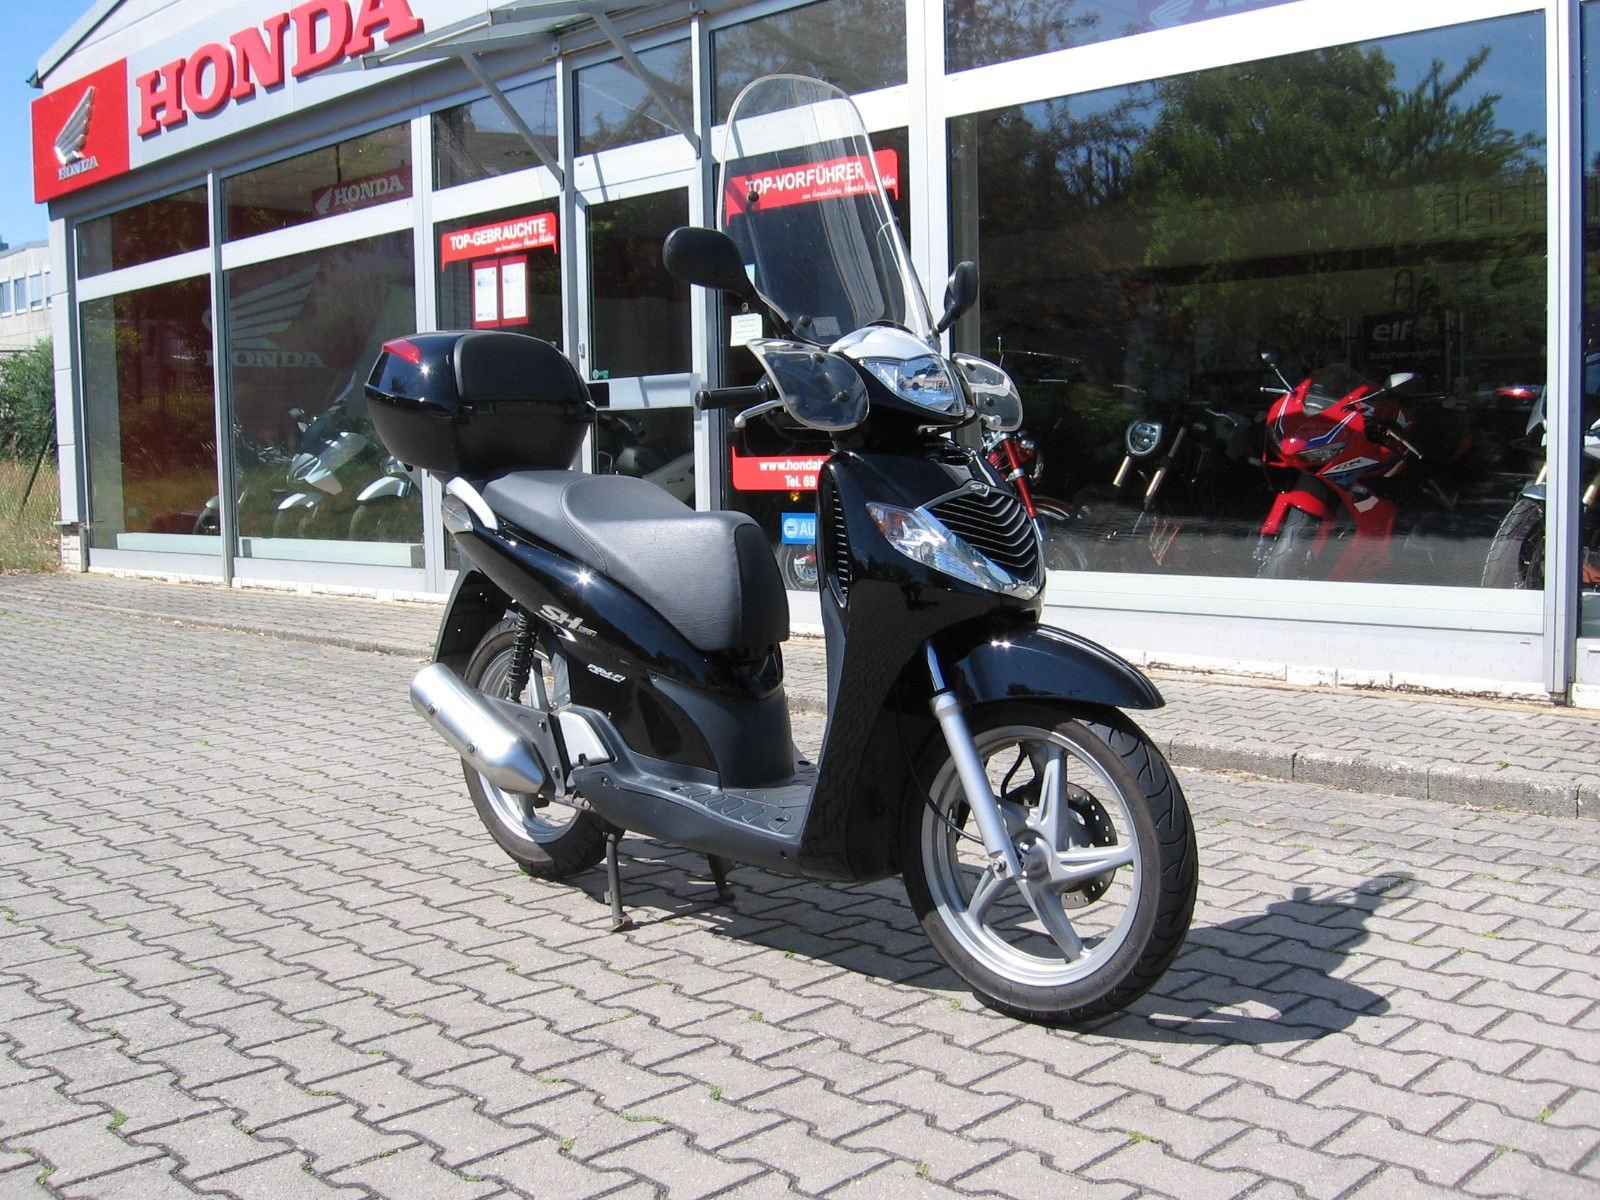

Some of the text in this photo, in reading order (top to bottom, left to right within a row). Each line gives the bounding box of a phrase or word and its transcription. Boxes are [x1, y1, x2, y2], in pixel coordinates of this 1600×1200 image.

[136, 0, 424, 137] HONDA
[59, 156, 98, 180] HONDA
[745, 160, 865, 200] TOP-VORFÜHRER
[334, 174, 404, 206] HONDA
[450, 218, 546, 251] TOP-GEBRAUCHTE
[1372, 320, 1413, 341] elf
[784, 475, 801, 487] Tel.
[540, 604, 584, 630] SH
